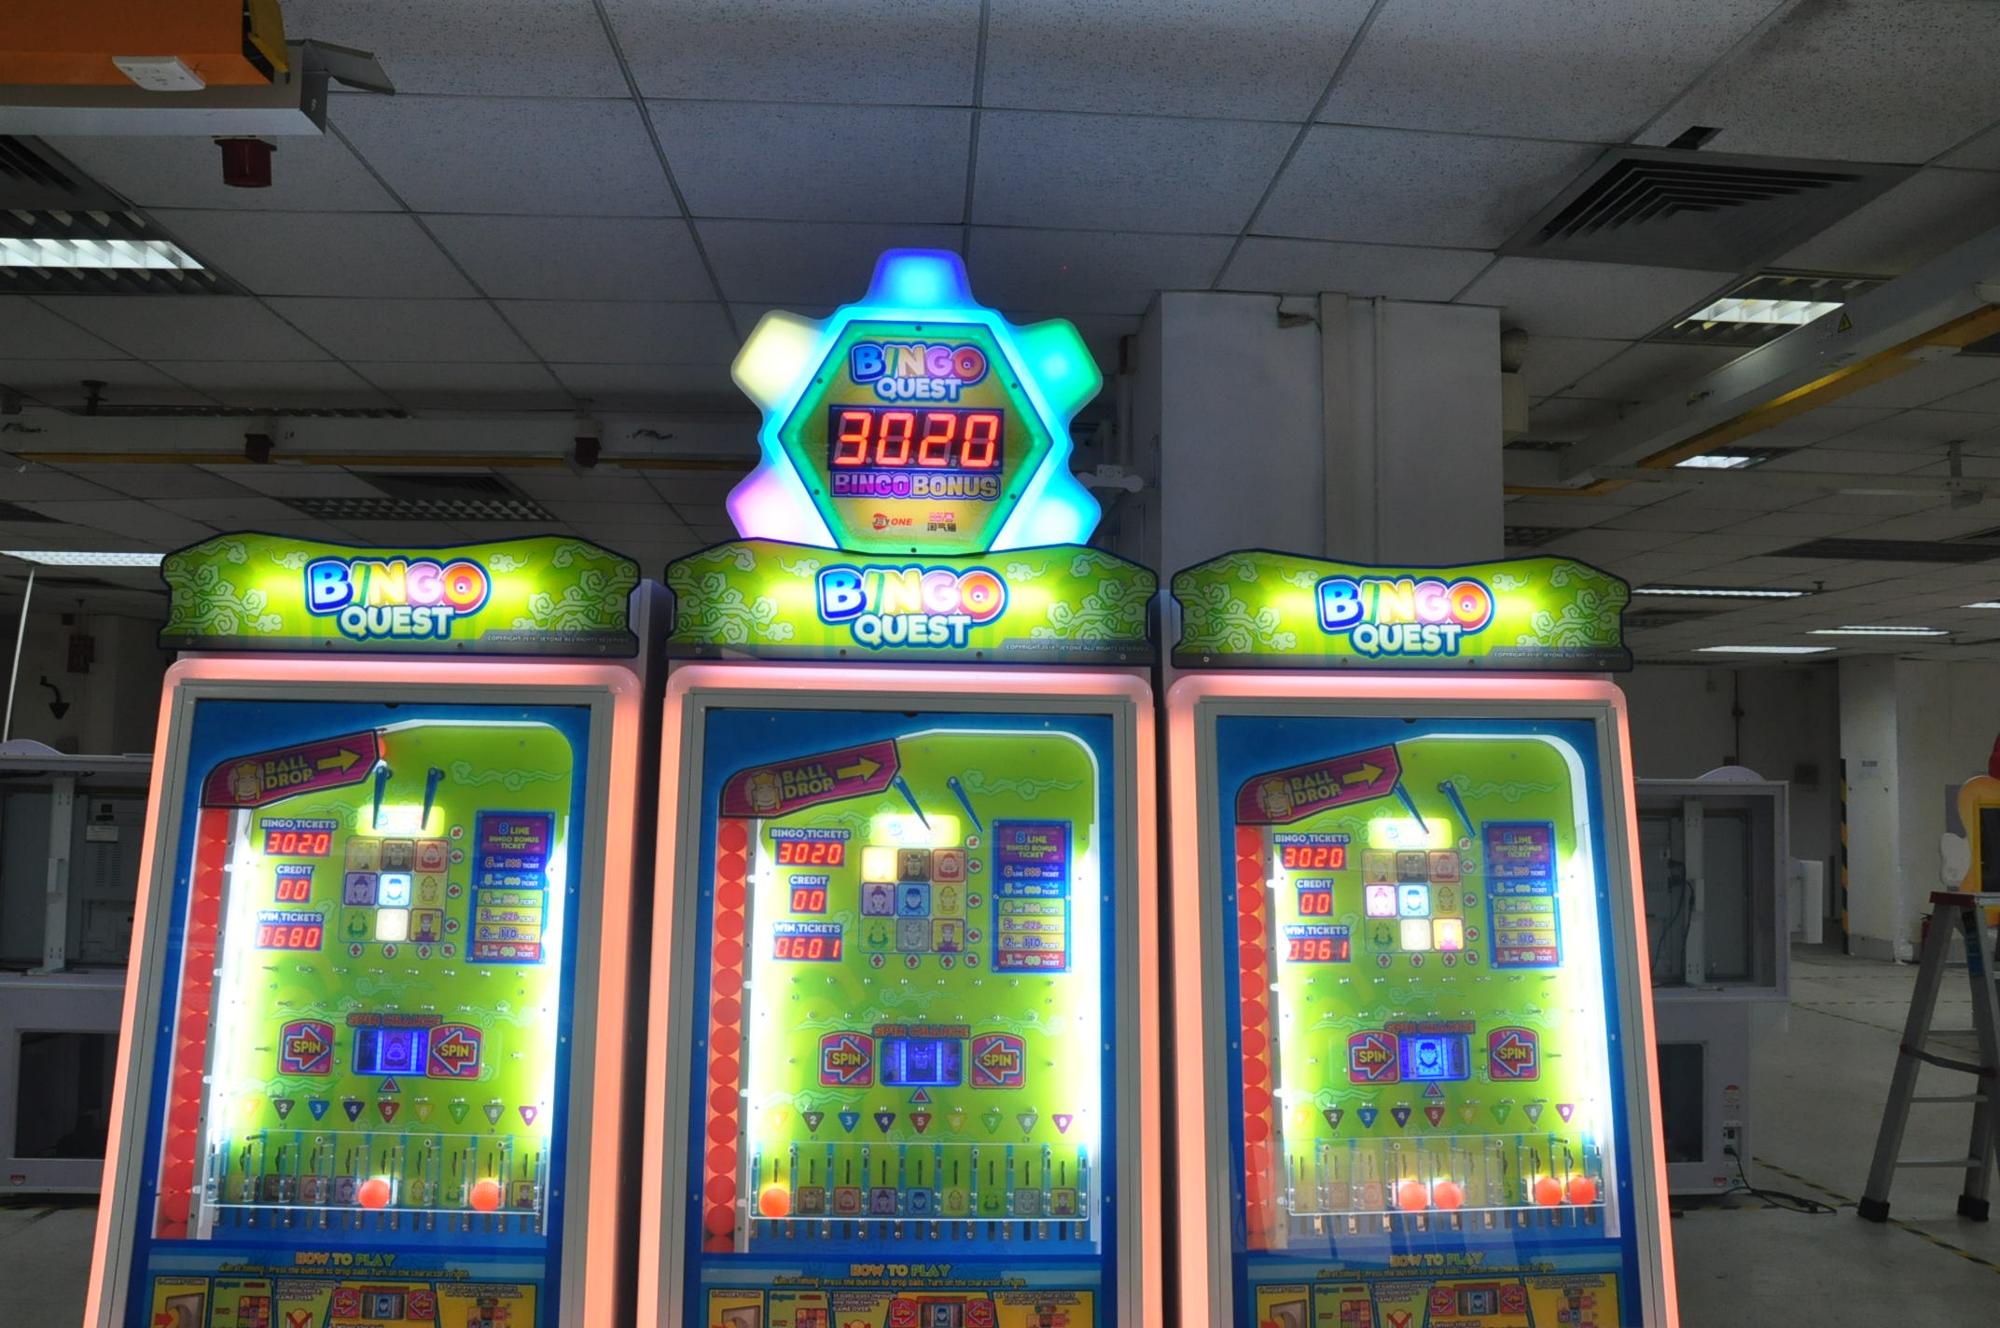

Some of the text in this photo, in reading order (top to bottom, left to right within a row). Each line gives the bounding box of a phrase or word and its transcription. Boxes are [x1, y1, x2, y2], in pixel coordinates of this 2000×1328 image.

[851, 343, 987, 383] BINGO
[877, 378, 962, 399] QUEST
[834, 411, 999, 468] 3020
[834, 474, 998, 497] BINGO BONUS
[308, 560, 488, 614] BINGO
[820, 568, 1006, 622] BINGO
[1319, 578, 1492, 632] BINGO
[340, 606, 454, 637] QUEST
[854, 615, 972, 647] QUEST
[1354, 625, 1460, 653] QUEST
[265, 755, 308, 774] BALL
[782, 764, 827, 783] BALL
[266, 769, 314, 790] DROP
[783, 777, 835, 799] DROP
[1292, 770, 1334, 789] BALL
[1293, 783, 1343, 805] DROP
[262, 820, 336, 829] BINGO TICKETS
[771, 829, 849, 839] BINGO TICKETS
[267, 832, 329, 853] 3020
[1275, 834, 1349, 843] BINGO TICKETS
[779, 843, 842, 864] 3020
[1284, 847, 1344, 868] 3020
[277, 866, 312, 875] CREDIT
[277, 879, 309, 899] 00
[790, 876, 828, 885] CREDIT
[1296, 879, 1333, 888] CREDIT
[792, 890, 825, 911] 00
[1301, 894, 1330, 914] 00
[259, 913, 322, 922] WIN TICKETS
[775, 924, 840, 933] WIN TICKETS
[1286, 926, 1348, 935] WIN TICKETS
[776, 937, 840, 958] 0601
[293, 1041, 320, 1053] SPIN
[441, 1045, 468, 1057] SPIN
[1500, 1047, 1526, 1059] SPIN
[832, 1054, 861, 1066] SPIN
[984, 1054, 1012, 1066] SPIN
[1359, 1051, 1386, 1063] SPIN
[295, 1253, 395, 1267] HOW TO PLAY
[1390, 1252, 1484, 1267] HOW TO PLAY
[850, 1264, 952, 1277] HOW TO PLAY
